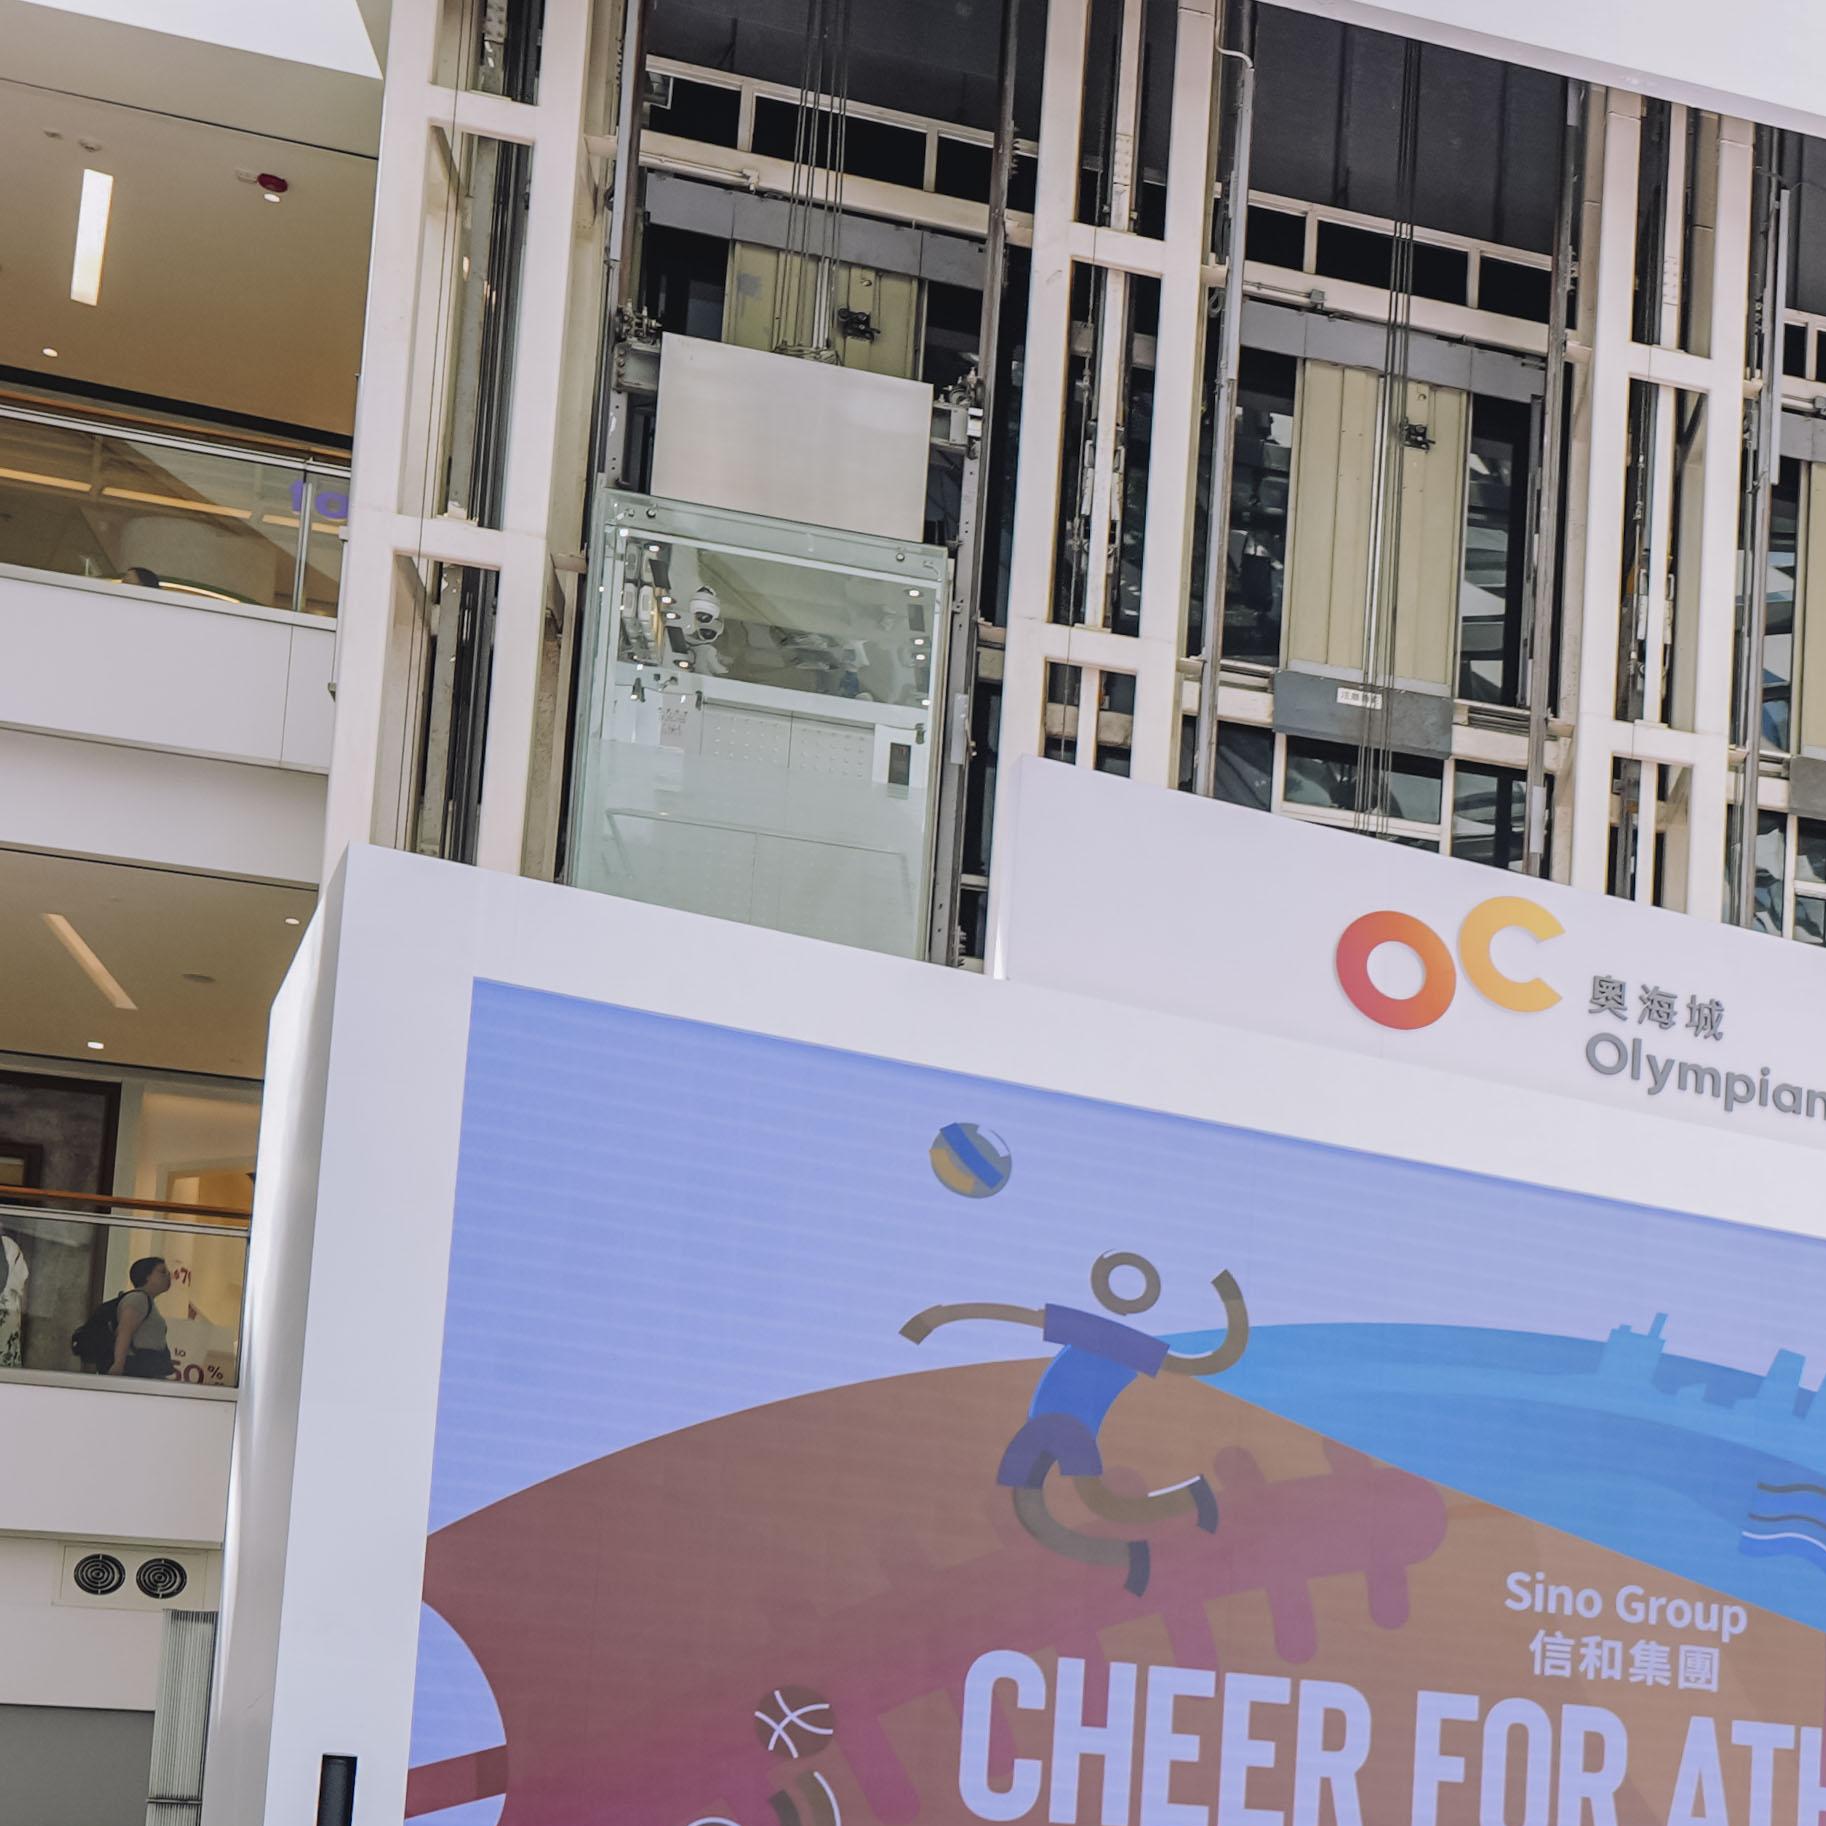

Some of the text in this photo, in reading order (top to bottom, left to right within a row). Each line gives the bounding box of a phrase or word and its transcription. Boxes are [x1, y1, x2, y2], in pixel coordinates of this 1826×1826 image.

[1335, 896, 1566, 1030] OC
[1587, 974, 1726, 1042] 奧海城
[1504, 1570, 1749, 1643] Sino Group
[1527, 1628, 1723, 1693] 信和集團
